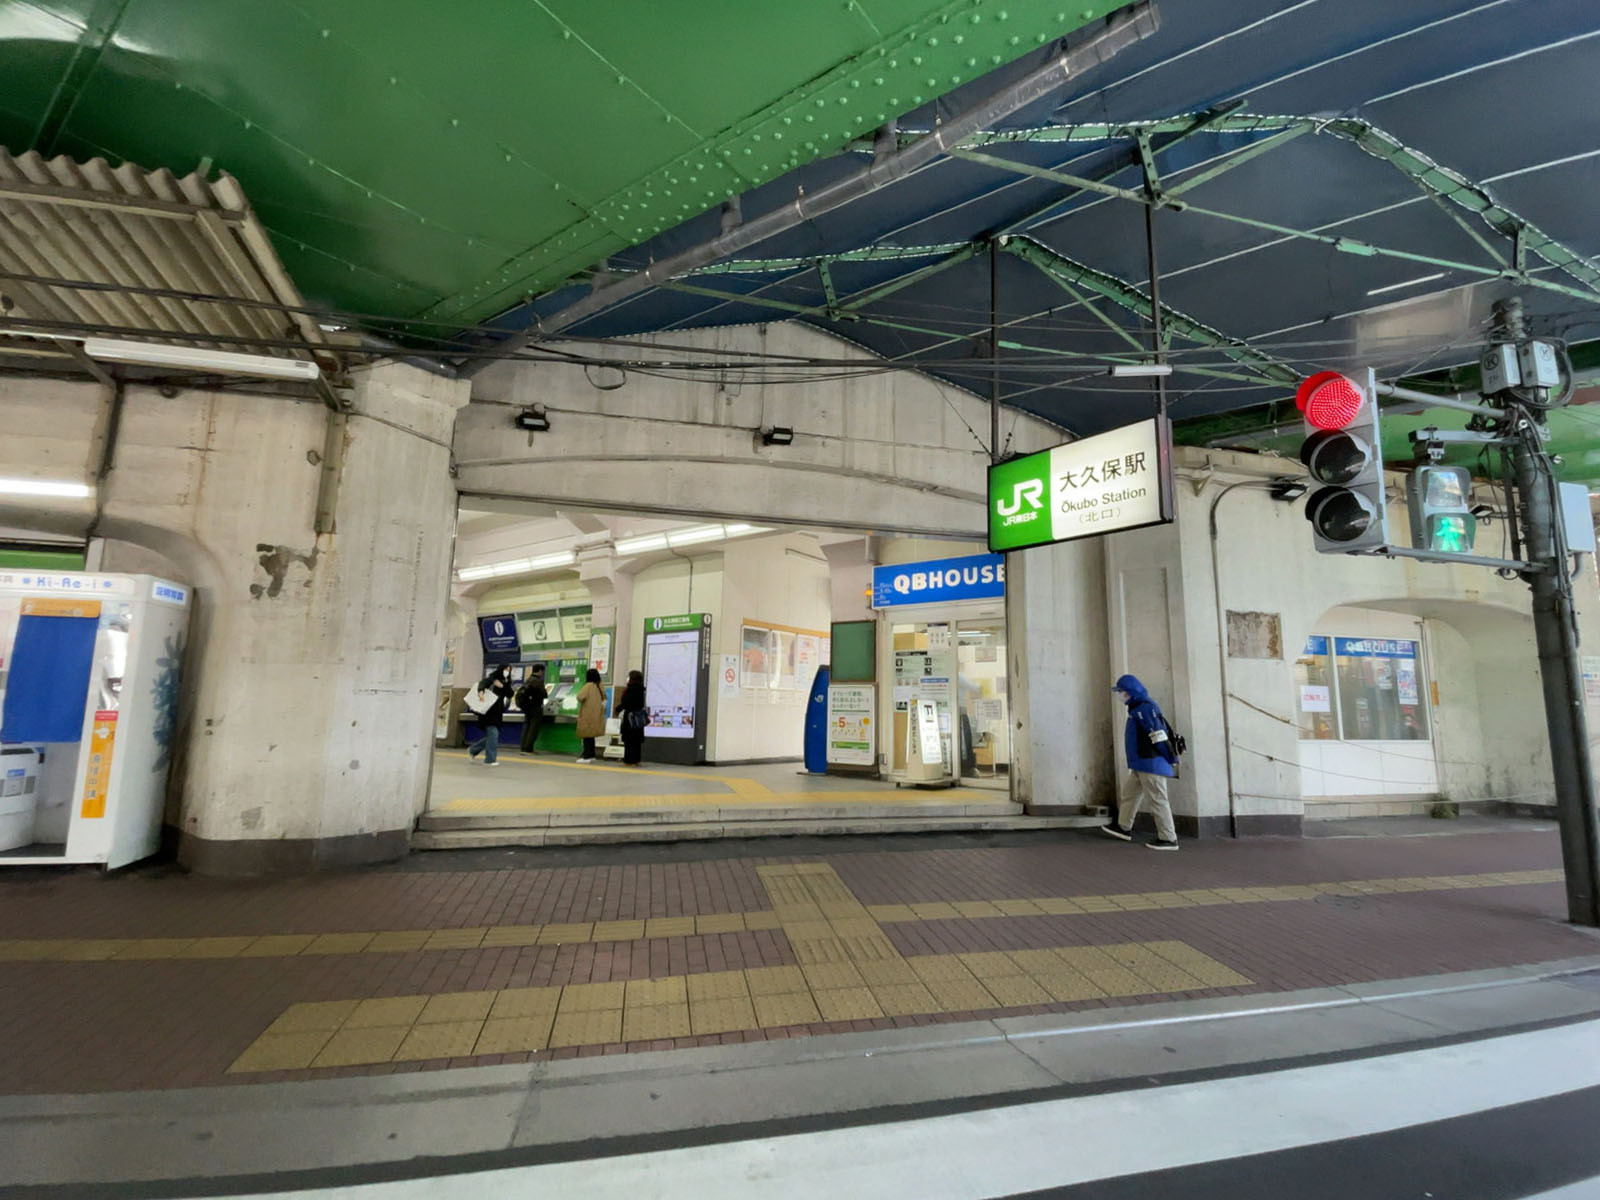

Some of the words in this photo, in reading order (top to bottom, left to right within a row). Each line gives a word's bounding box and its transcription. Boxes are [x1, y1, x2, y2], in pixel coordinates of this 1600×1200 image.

[1060, 452, 1146, 492] 大久保駅
[997, 478, 1044, 516] JR
[1102, 487, 1147, 505] Station
